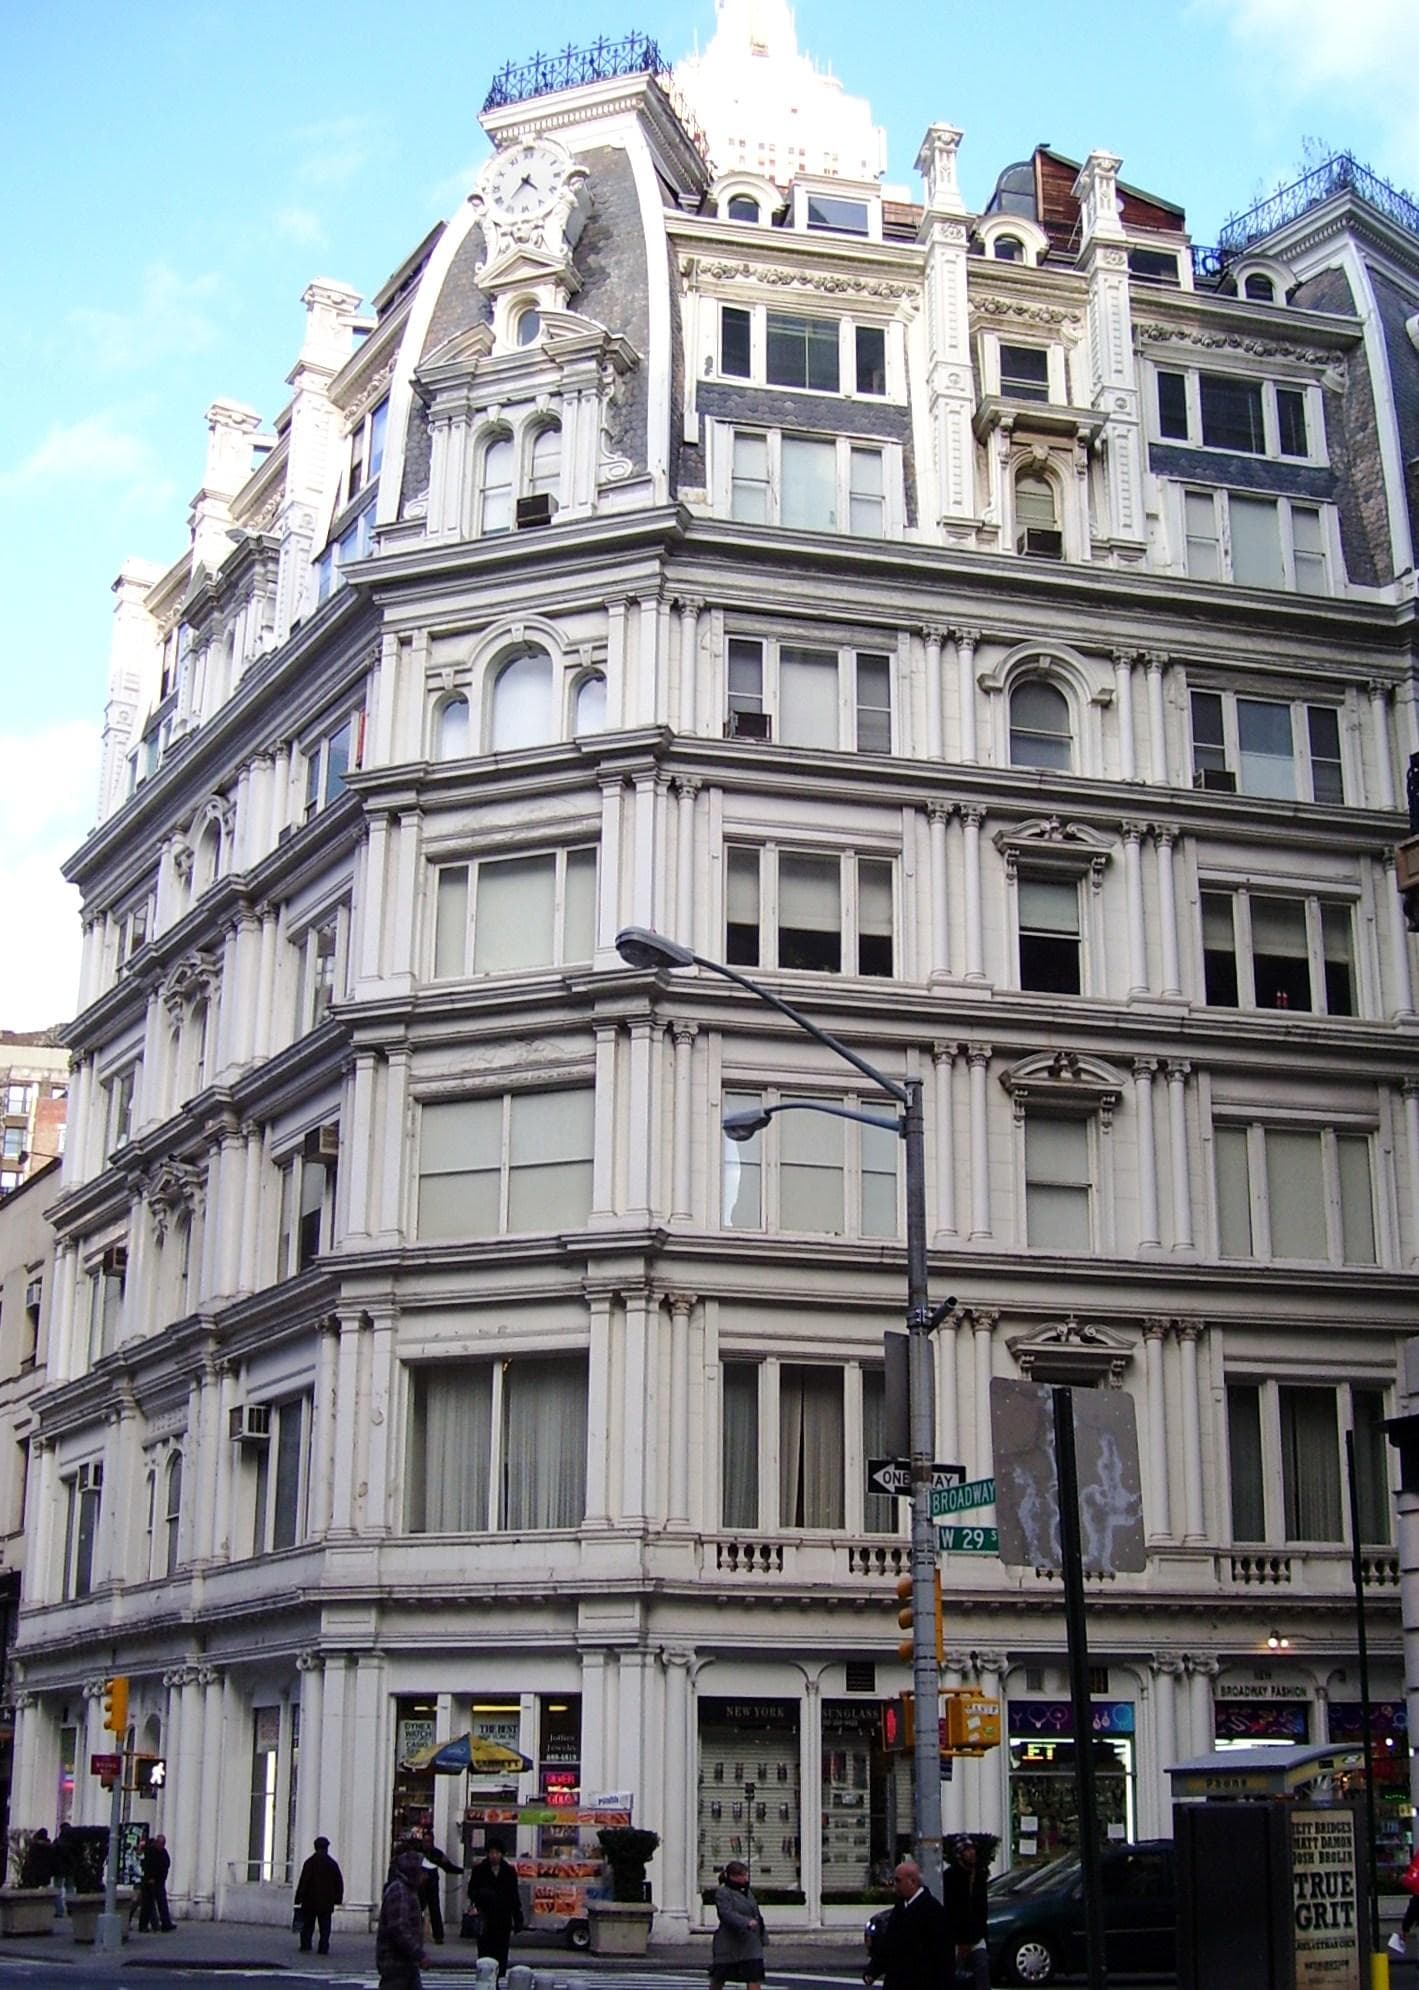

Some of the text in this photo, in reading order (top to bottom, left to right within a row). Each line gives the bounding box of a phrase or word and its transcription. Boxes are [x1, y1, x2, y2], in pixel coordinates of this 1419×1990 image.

[883, 1471, 954, 1489] ONE AY
[932, 1481, 996, 1514] BROADWAY
[941, 1529, 955, 1549] W
[962, 1529, 985, 1549] 29
[1220, 1685, 1308, 1697] BROADWAY FASHION
[726, 1705, 785, 1718] NEW YORK
[1320, 1835, 1353, 1849] DAMON
[1294, 1871, 1355, 1899] TRUE
[1295, 1901, 1355, 1931] GRIT
